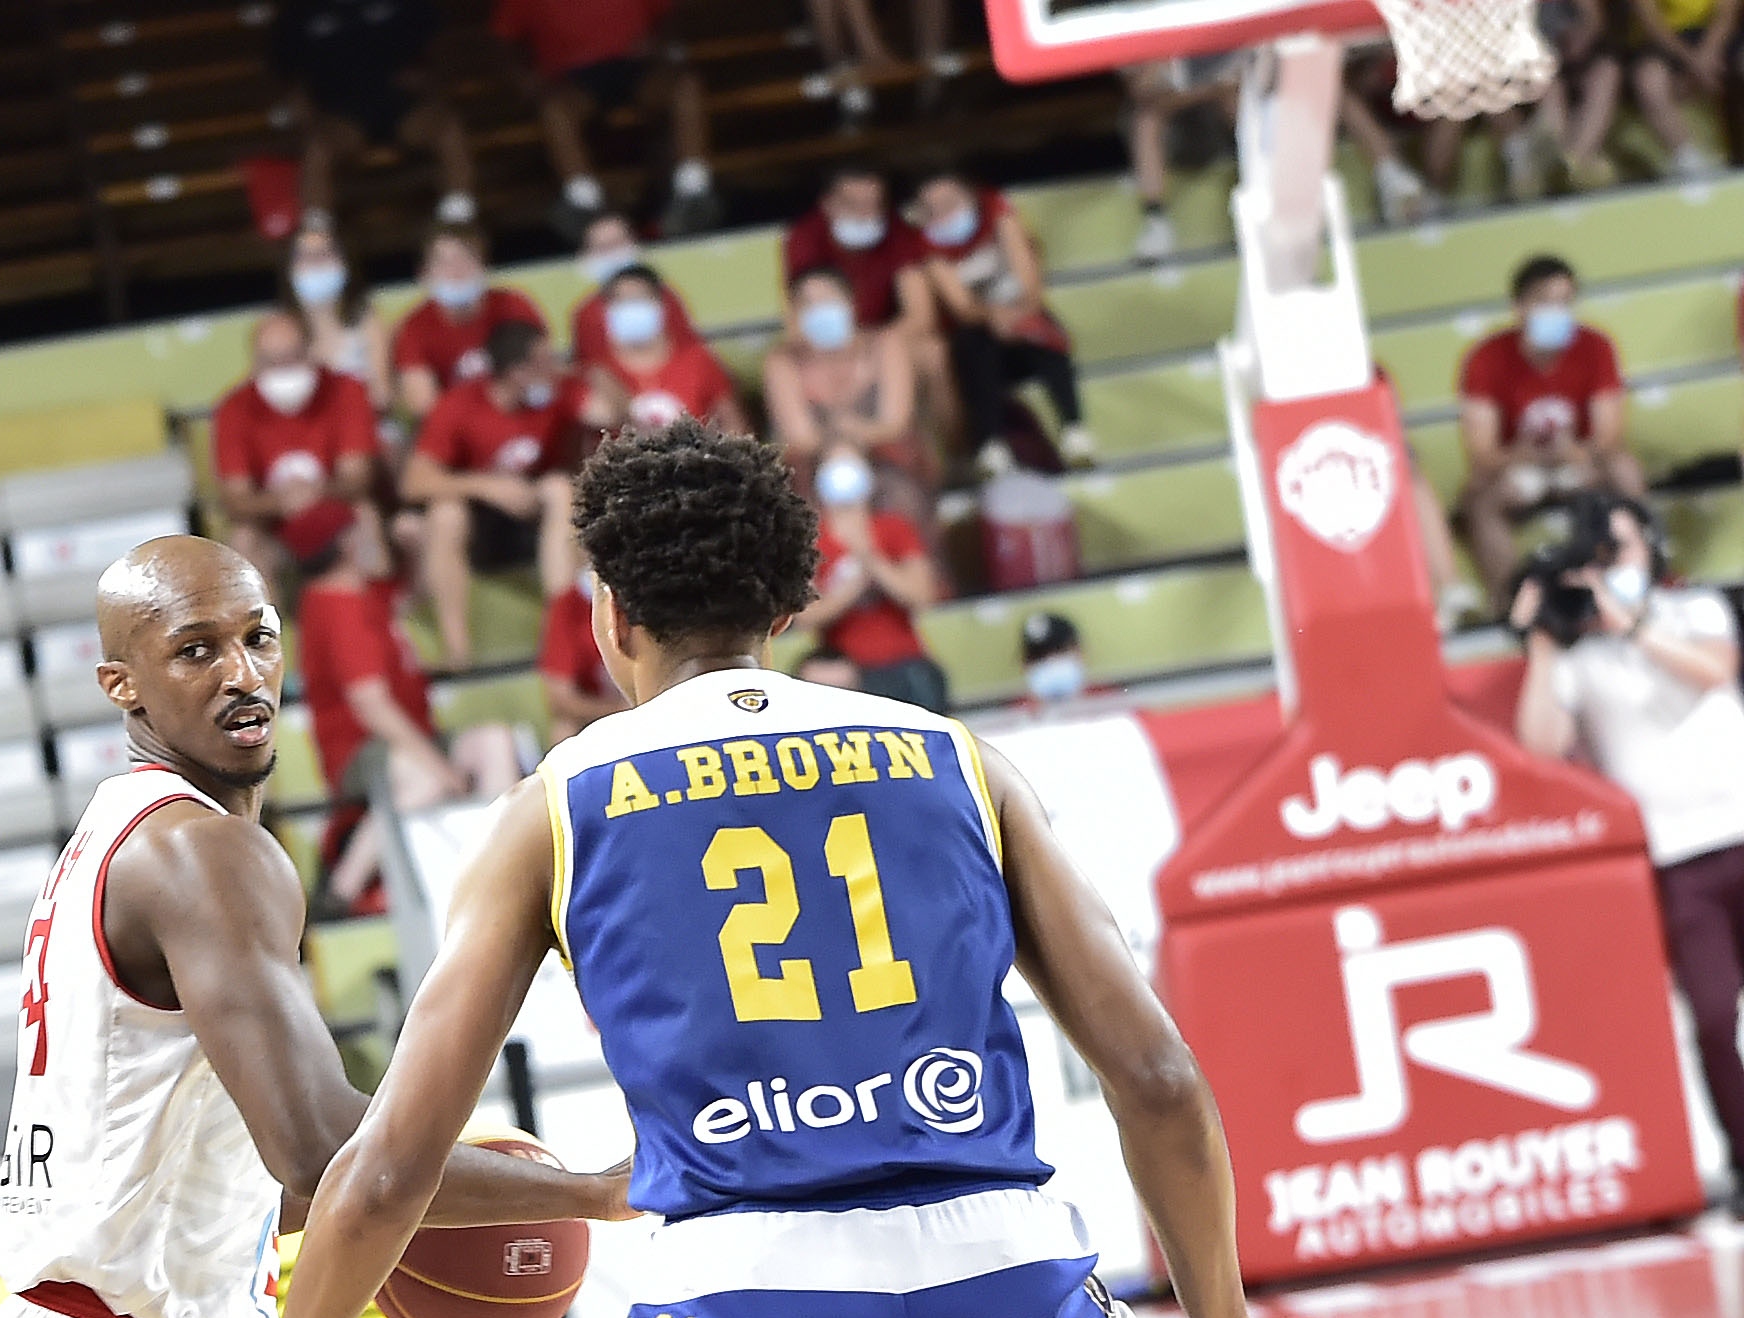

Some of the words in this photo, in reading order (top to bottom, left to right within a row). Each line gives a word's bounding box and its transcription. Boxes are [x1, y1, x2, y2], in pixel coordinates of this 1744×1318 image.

[605, 732, 934, 818] A.BROWN
[1282, 753, 1495, 837] Jeep
[701, 813, 918, 1022] 21
[692, 1072, 893, 1145] elior
[1264, 1152, 1406, 1235] JEAN
[1416, 1115, 1639, 1199] ROUYER
[1296, 1175, 1627, 1260] AUTOMOBILES
